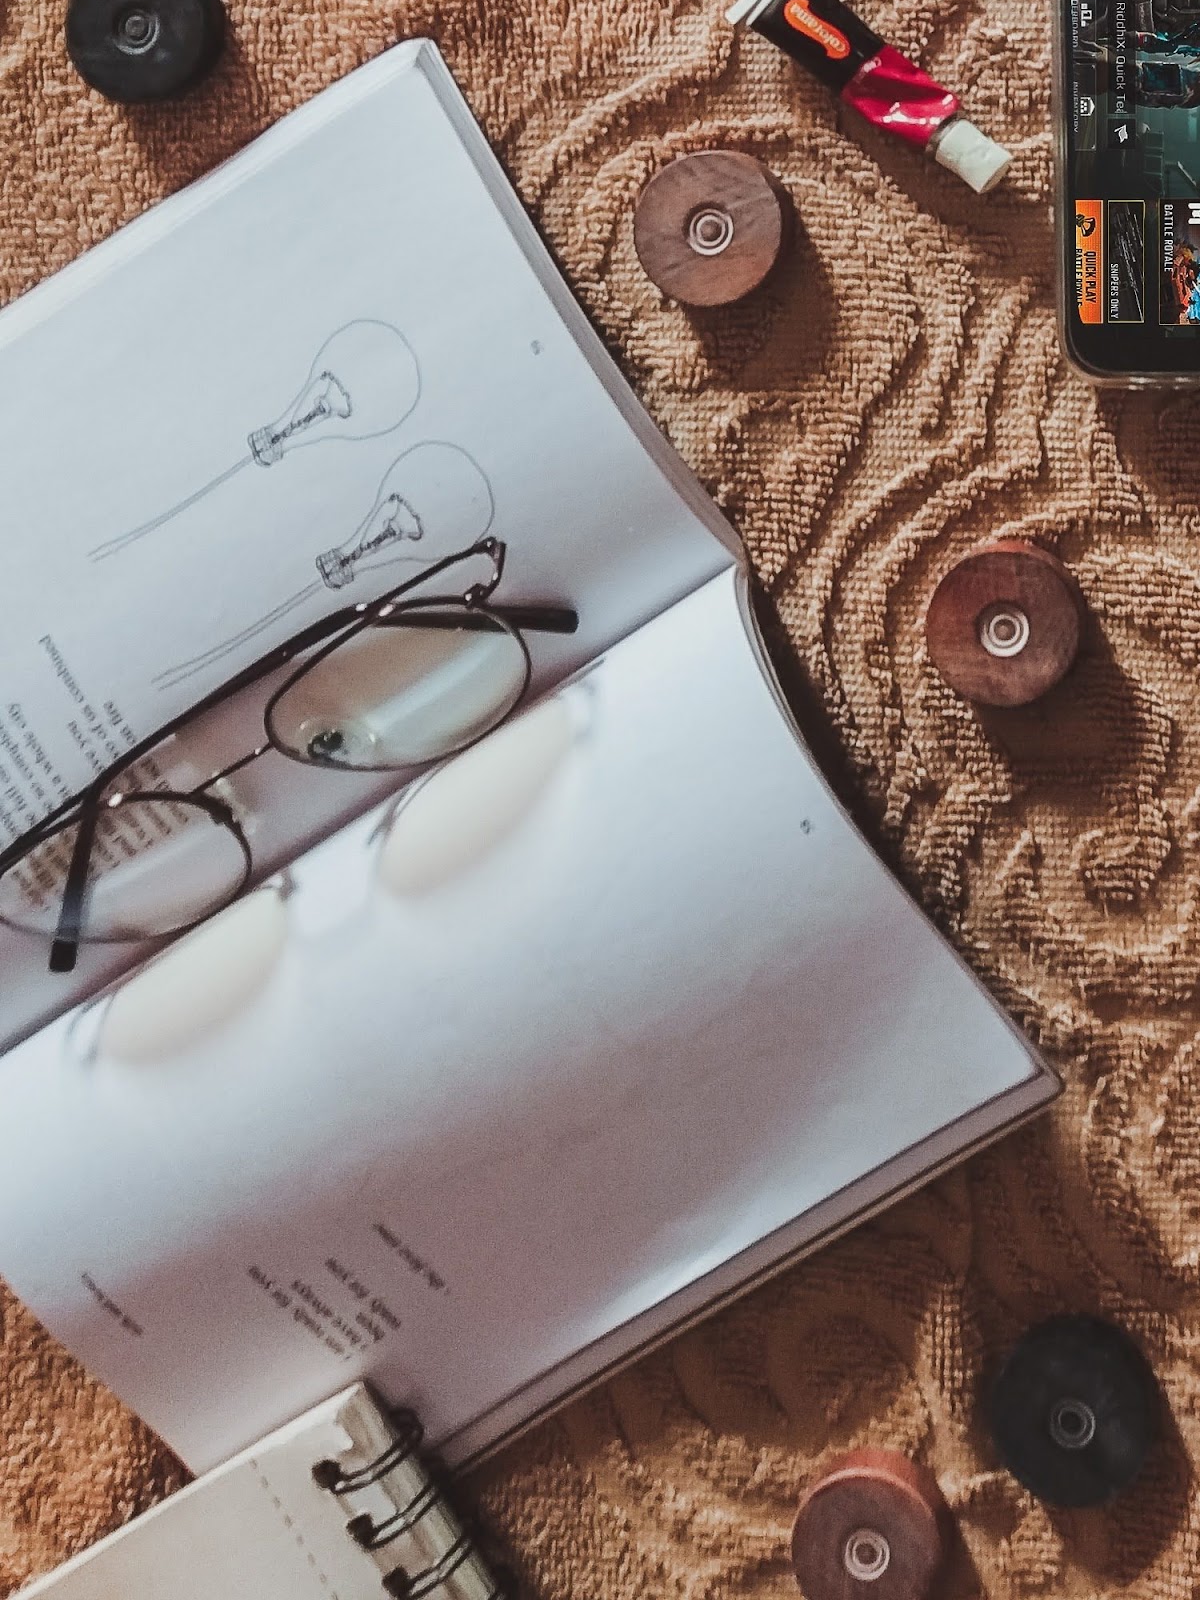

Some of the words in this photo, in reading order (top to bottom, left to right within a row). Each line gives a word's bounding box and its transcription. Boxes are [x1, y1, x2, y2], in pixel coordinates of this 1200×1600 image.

[790, 2, 846, 52] colorama
[1115, 55, 1126, 90] Quick
[1164, 204, 1173, 236] BATTLE
[1084, 251, 1096, 278] QUICK
[1164, 239, 1173, 272] ROYALE
[1085, 279, 1096, 303] PLAY
[1110, 263, 1118, 296] SNIPERS
[1110, 298, 1118, 319] ONLY
[38, 634, 85, 703] combined
[7, 703, 26, 729] city
[104, 700, 124, 726] fire
[67, 720, 88, 749] you
[91, 723, 107, 741] of
[24, 731, 52, 774] whole
